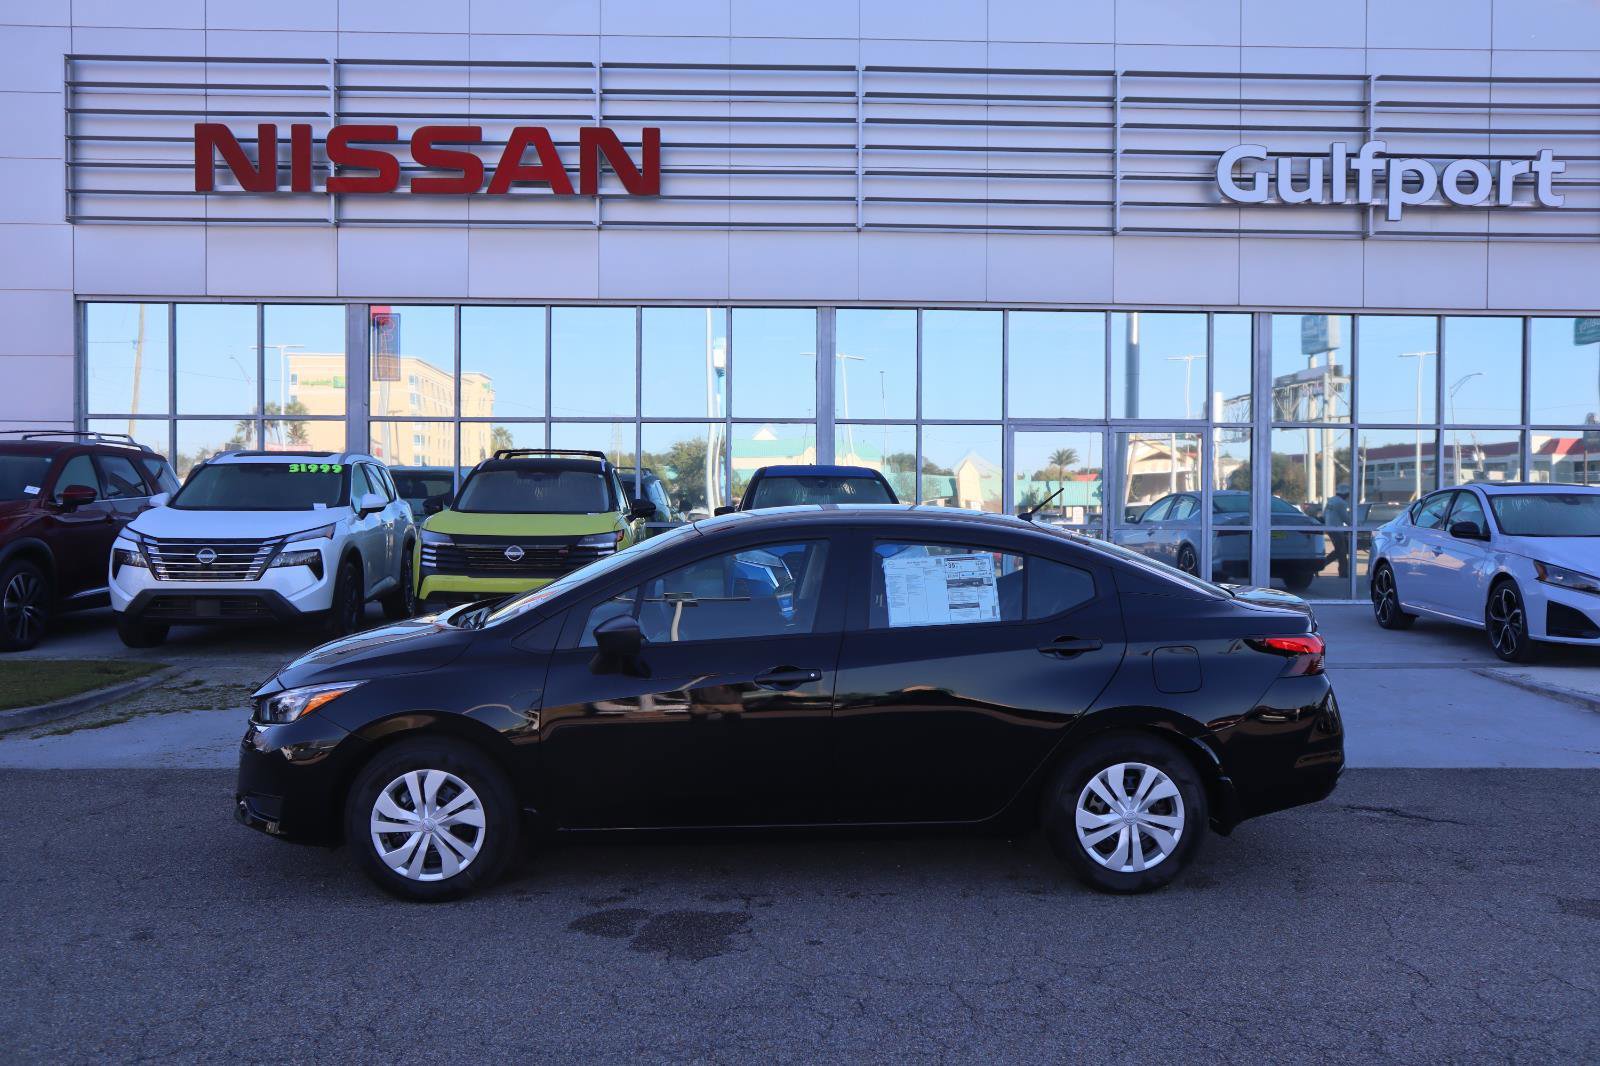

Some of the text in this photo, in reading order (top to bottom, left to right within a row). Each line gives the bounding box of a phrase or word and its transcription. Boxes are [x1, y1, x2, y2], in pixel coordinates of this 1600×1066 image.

[194, 123, 660, 196] NISSAN
[1216, 140, 1565, 221] Gulfport
[288, 463, 343, 473] 31999
